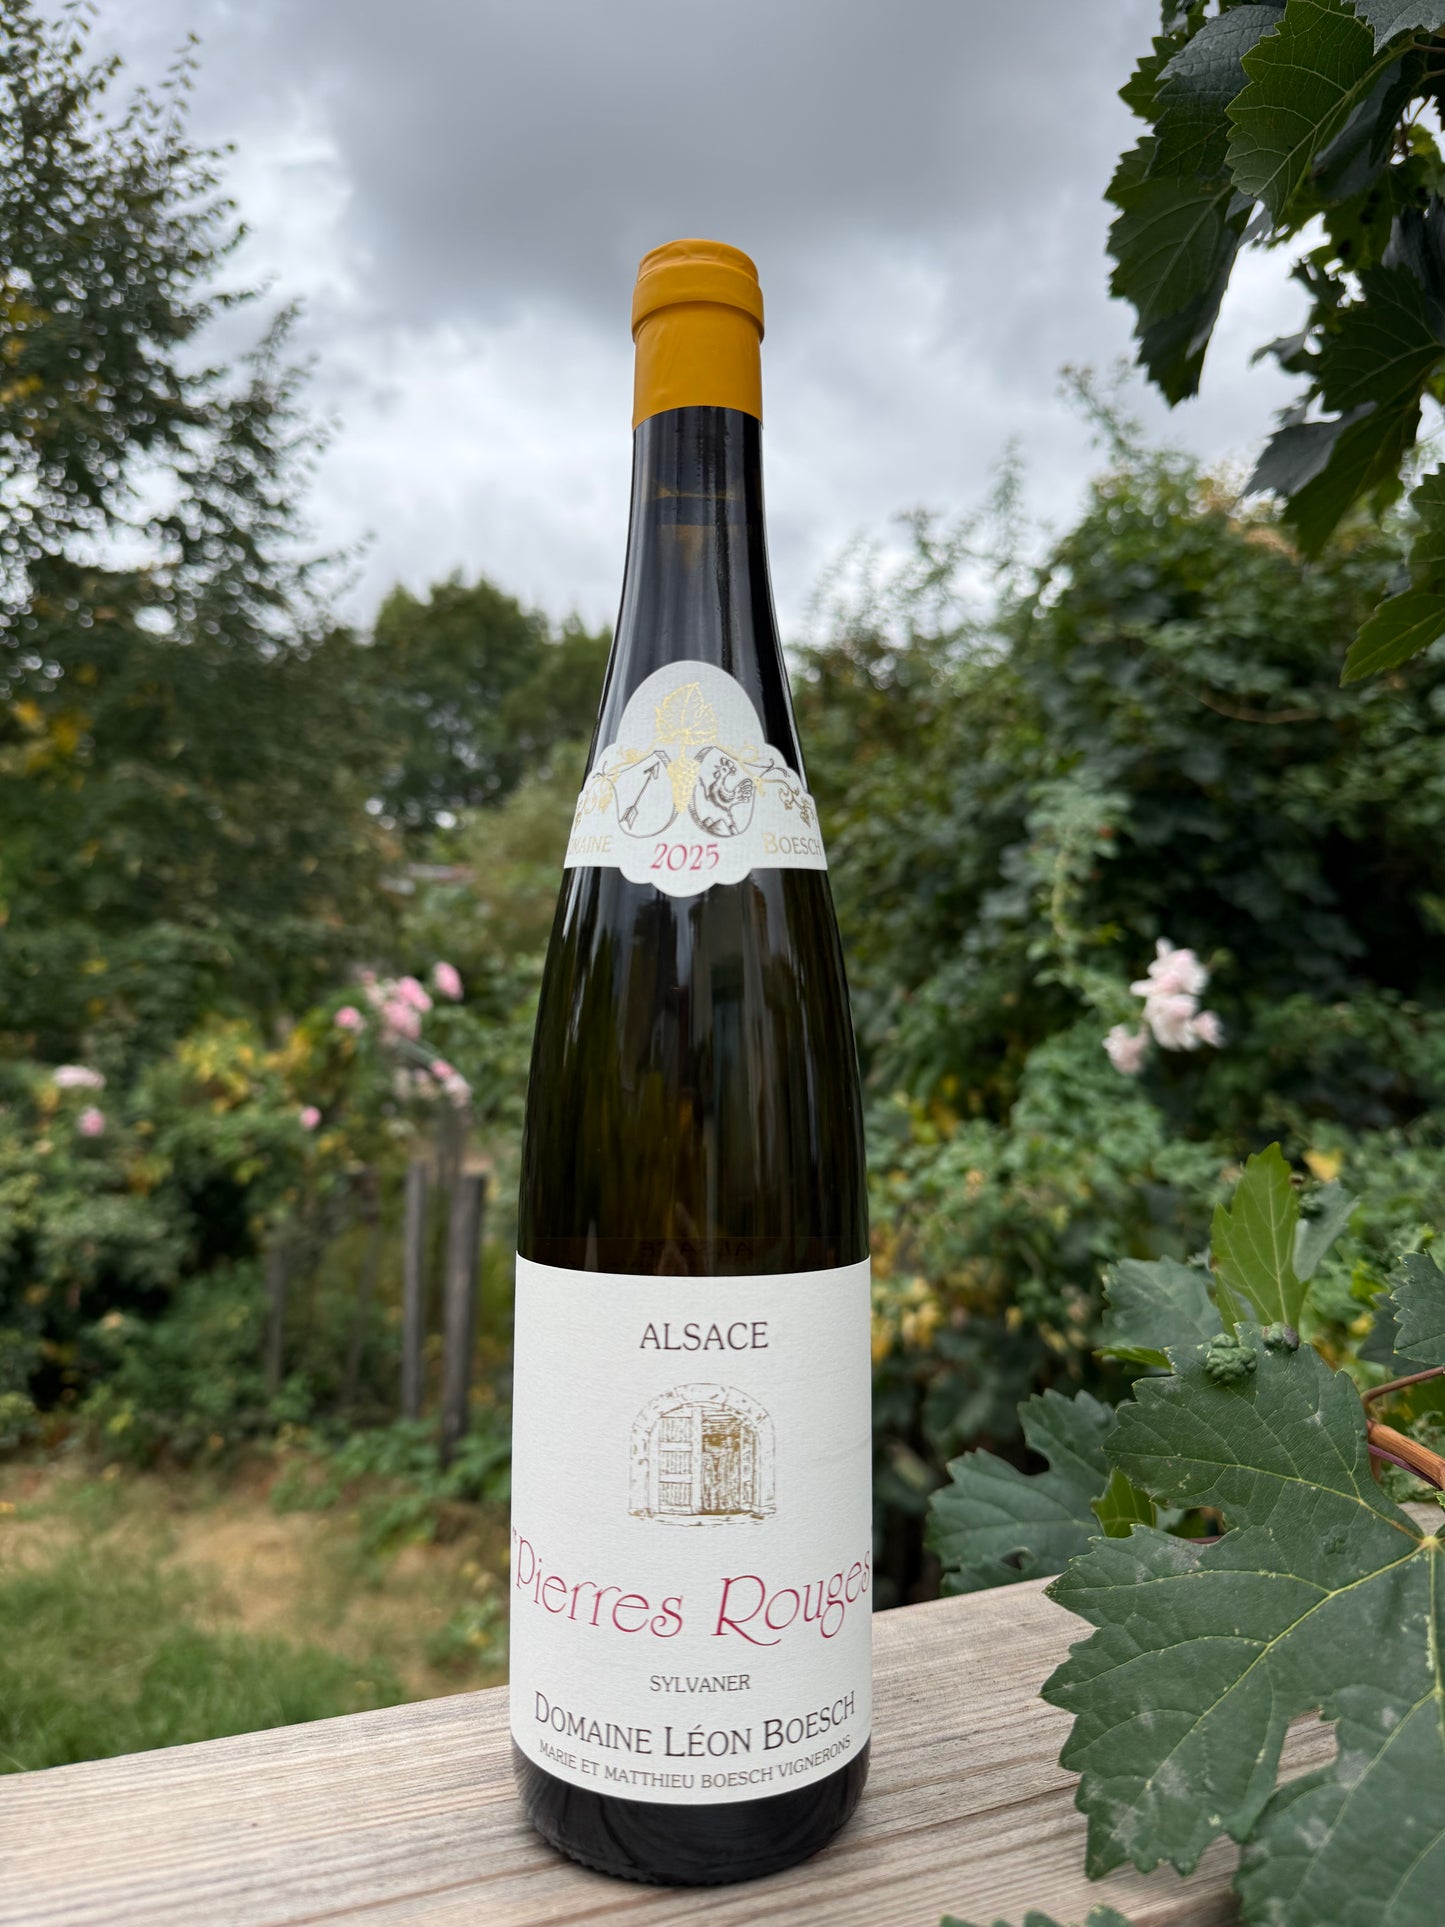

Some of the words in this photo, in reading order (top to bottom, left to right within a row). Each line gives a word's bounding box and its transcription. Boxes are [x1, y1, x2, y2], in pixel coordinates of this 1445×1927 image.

[651, 843, 720, 871] 2025
[762, 832, 822, 857] BOESCH
[639, 1321, 769, 1351] ALSACE
[711, 1550, 870, 1646] Rouges
[649, 1674, 751, 1693] SYLVANER
[535, 1691, 652, 1755] DOMAINE
[664, 1724, 751, 1757] LÉON
[763, 1691, 856, 1750] BOESCH
[539, 1739, 577, 1772] MARIE
[580, 1757, 600, 1775] ET
[604, 1764, 695, 1789] MATTHIEU
[701, 1766, 773, 1788] BOESCH
[777, 1734, 852, 1778] VIGNERONS
